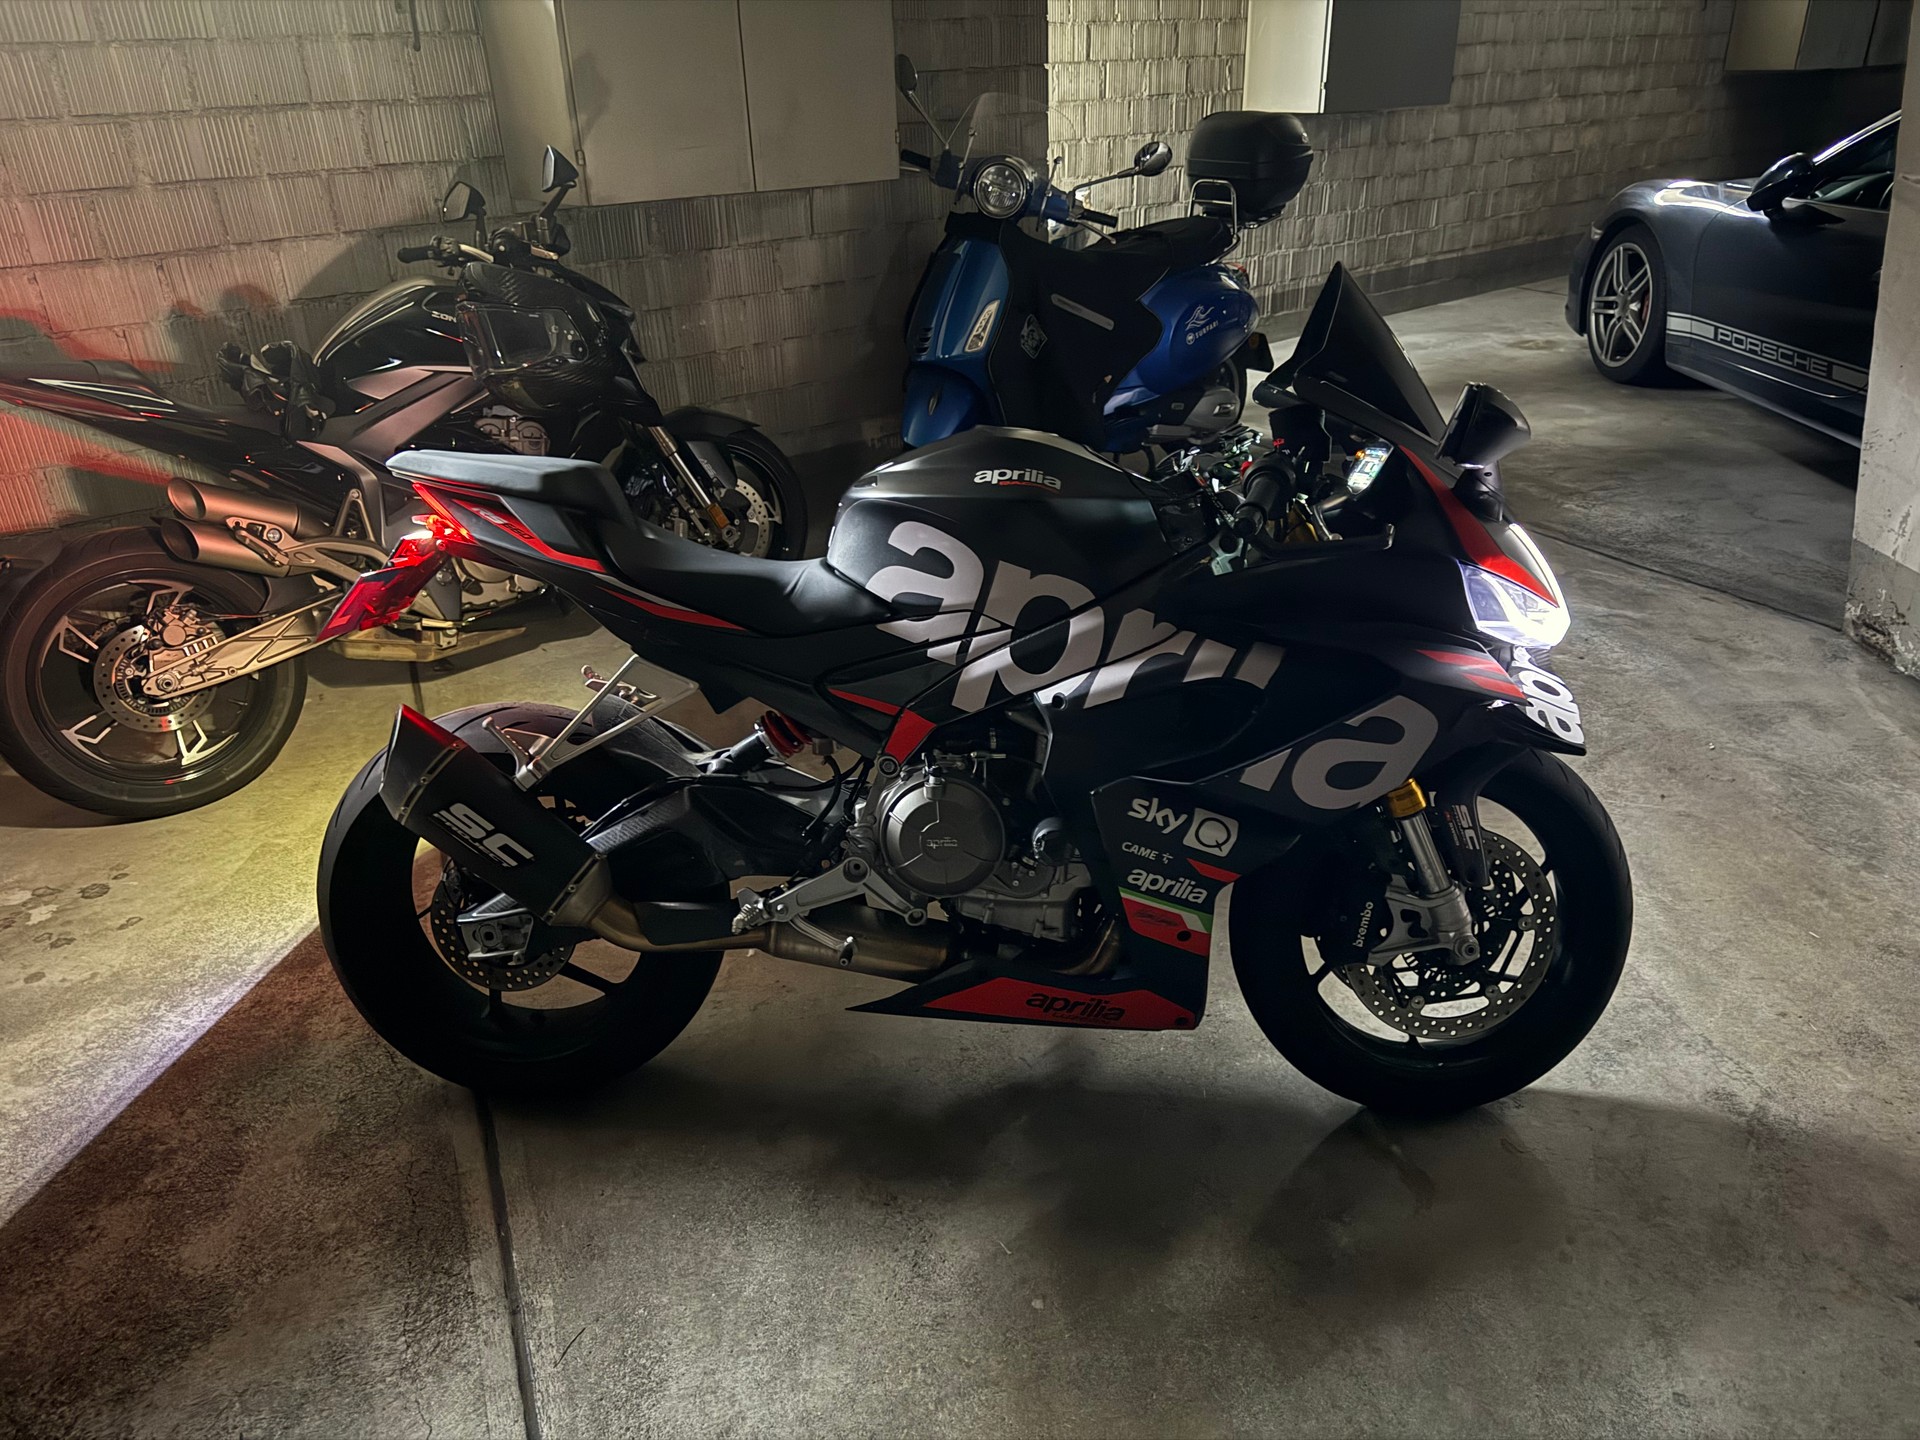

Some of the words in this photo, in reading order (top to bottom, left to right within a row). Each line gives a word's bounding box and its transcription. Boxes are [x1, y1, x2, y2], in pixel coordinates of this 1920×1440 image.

[1716, 328, 1828, 376] PORSCHE
[973, 468, 1061, 490] aprilia
[1127, 797, 1188, 834] sky
[439, 802, 535, 867] SC
[1121, 841, 1160, 860] CAME
[1126, 868, 1209, 904] aprilia
[1353, 901, 1374, 948] brembo
[1025, 992, 1126, 1022] aprilia
